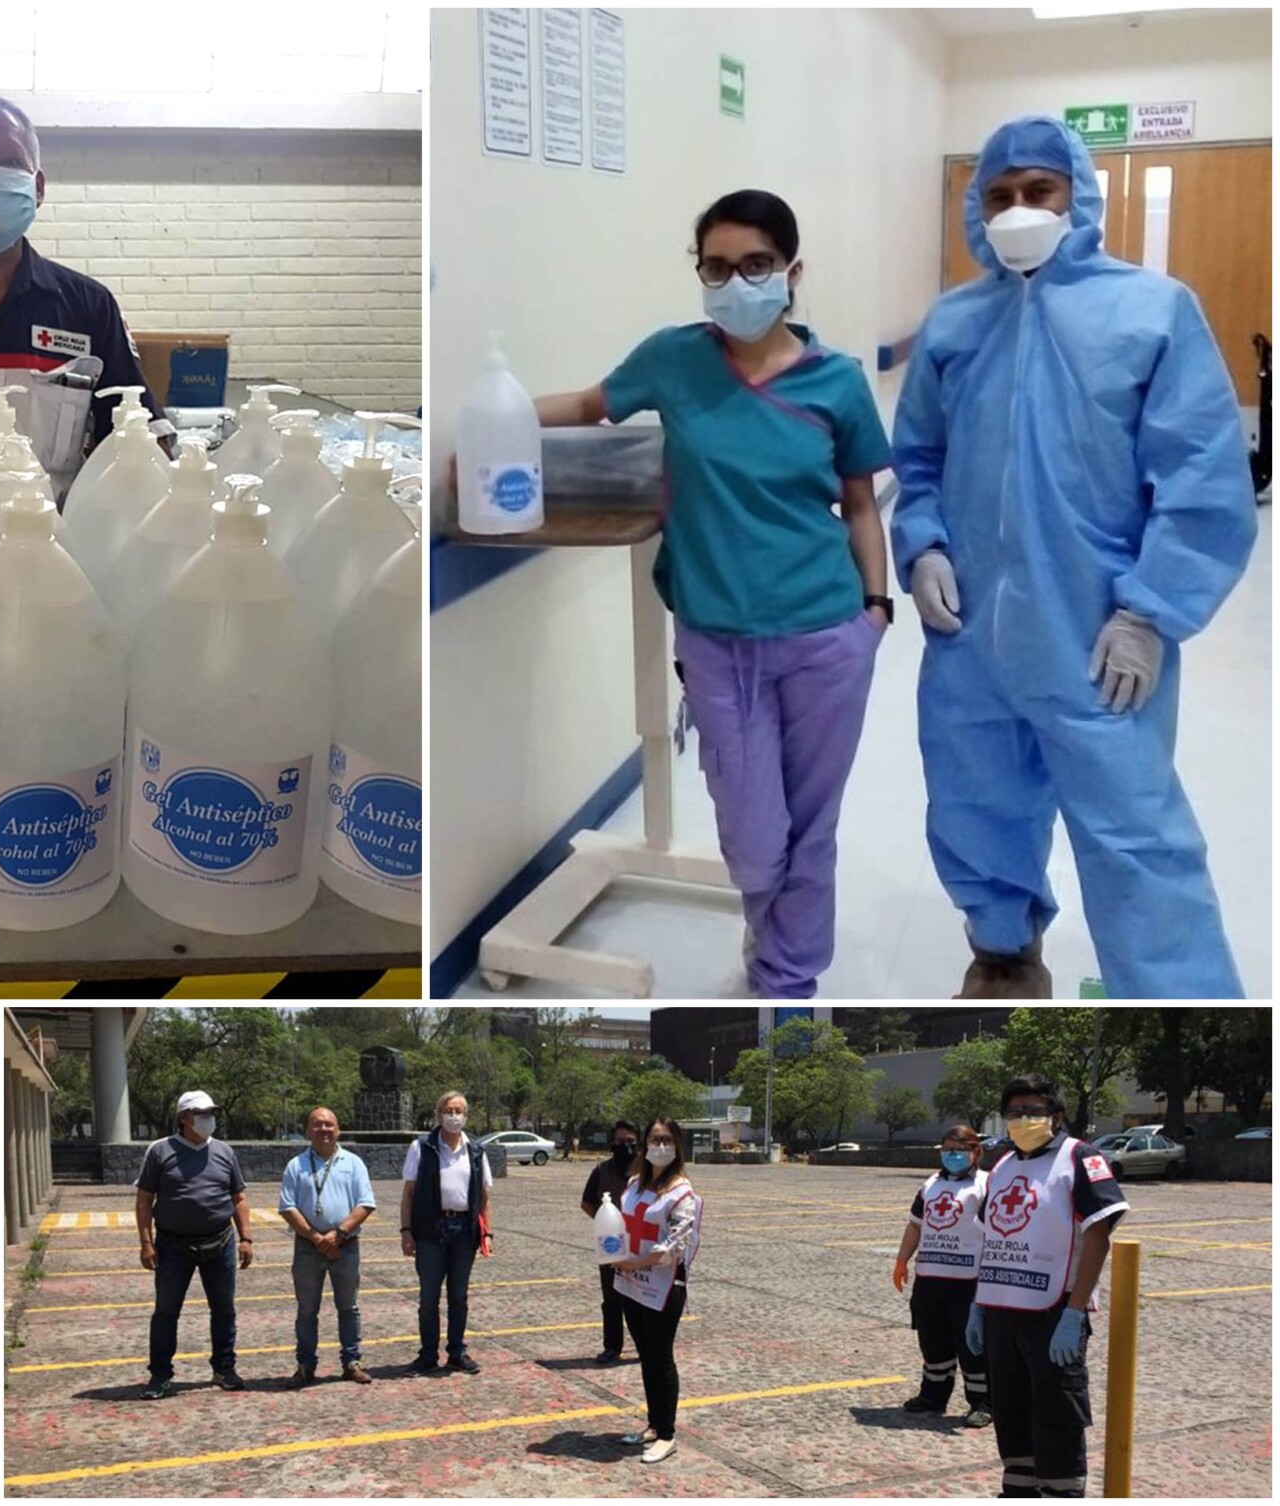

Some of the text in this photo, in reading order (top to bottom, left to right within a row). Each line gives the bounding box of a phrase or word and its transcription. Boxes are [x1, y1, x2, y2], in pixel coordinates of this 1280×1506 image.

[1138, 105, 1188, 116] EXCLUSIVO
[1141, 117, 1183, 128] ENTRADA
[1133, 129, 1190, 139] AMBULANCIA
[181, 374, 218, 386] Tyvek
[328, 783, 357, 812] Gel
[143, 781, 292, 830] Gel Antiséptico
[2, 804, 107, 837] Antiséptico
[153, 815, 278, 848] Alcohol al 70%
[337, 817, 417, 854] Alcohol al
[42, 843, 60, 859] al
[65, 829, 97, 855] 70%
[189, 849, 232, 864] NO BEBER
[17, 868, 58, 876] NO BEBER
[937, 1233, 960, 1242] ROJA
[1004, 1241, 1030, 1252] ROJA
[982, 1251, 1028, 1263] EXICANA
